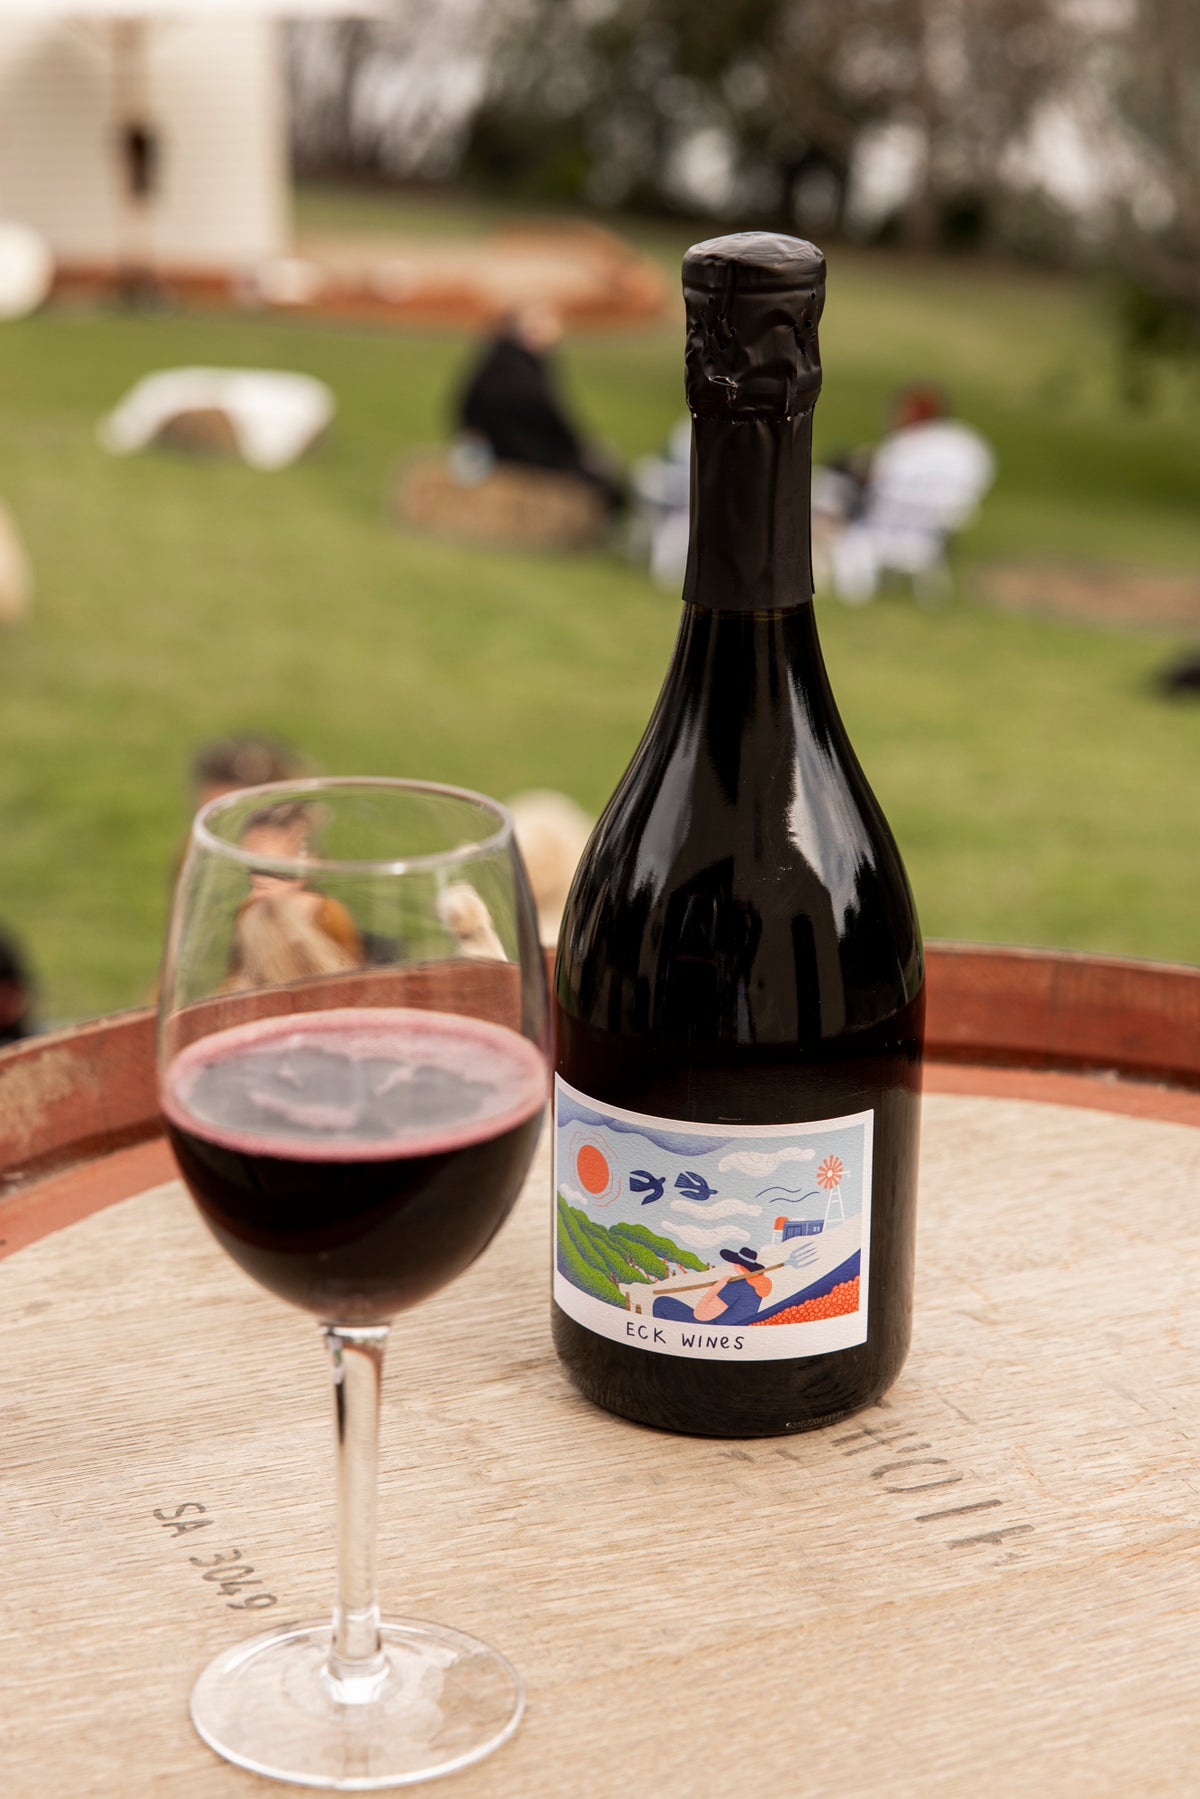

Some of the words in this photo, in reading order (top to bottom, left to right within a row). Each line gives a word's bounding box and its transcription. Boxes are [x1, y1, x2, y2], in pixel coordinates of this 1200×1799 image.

[626, 1321, 666, 1344] ECK
[153, 1502, 215, 1538] SA
[189, 1549, 278, 1610] 3049
